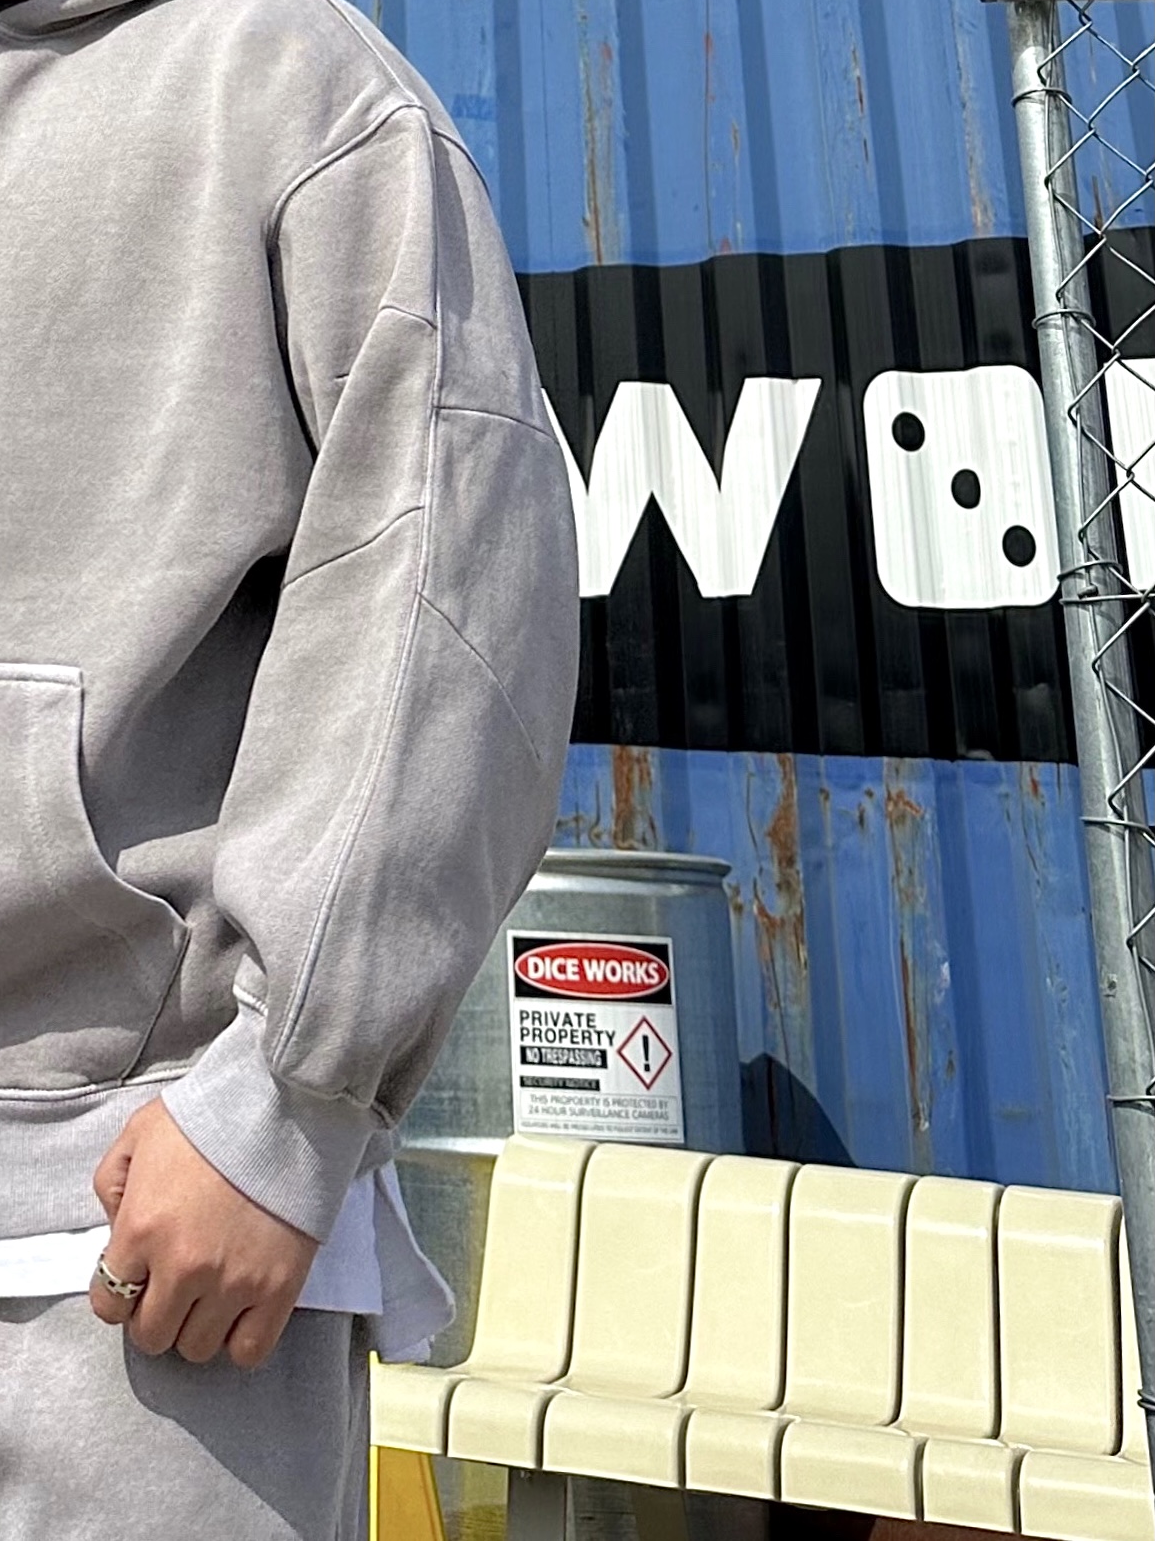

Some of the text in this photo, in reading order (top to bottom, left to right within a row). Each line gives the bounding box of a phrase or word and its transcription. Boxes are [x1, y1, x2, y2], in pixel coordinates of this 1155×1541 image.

[527, 956, 660, 985] DICE WORKS
[519, 1009, 597, 1029] PRIVATE
[519, 1027, 616, 1047] PROPERTY
[525, 1047, 602, 1067] NO TRESPASSING
